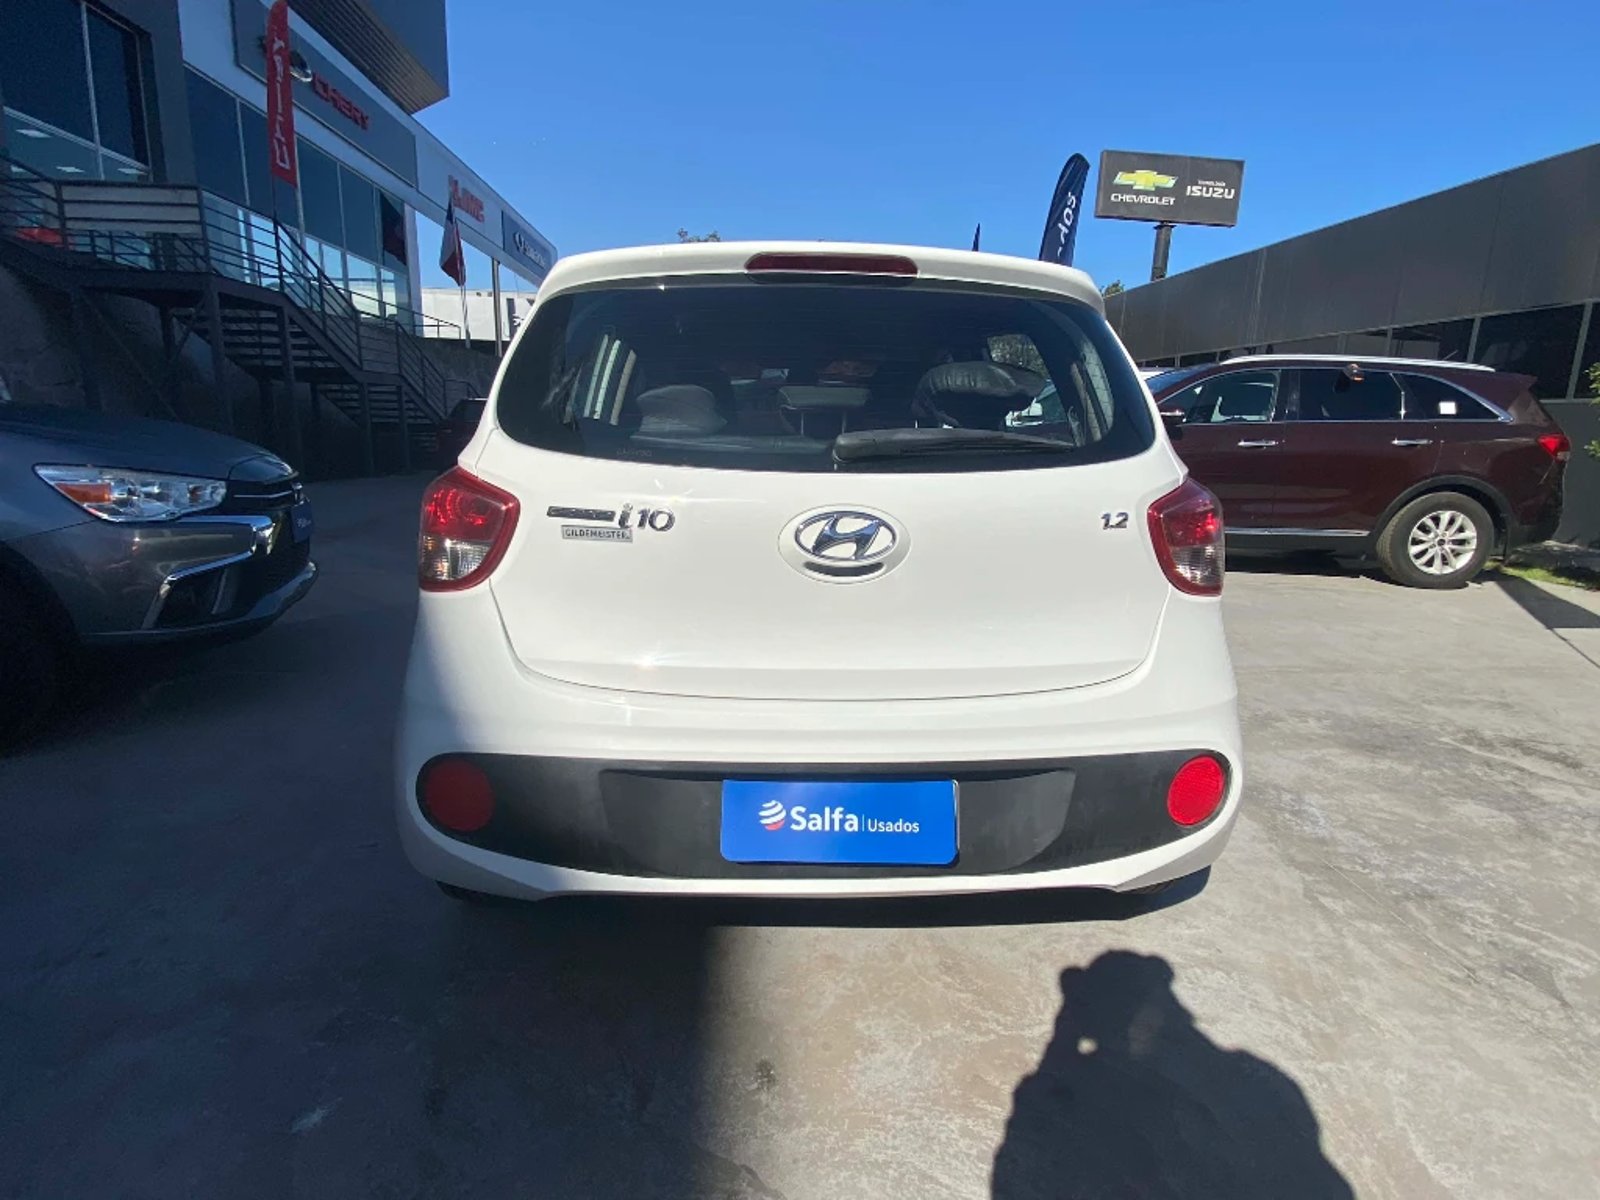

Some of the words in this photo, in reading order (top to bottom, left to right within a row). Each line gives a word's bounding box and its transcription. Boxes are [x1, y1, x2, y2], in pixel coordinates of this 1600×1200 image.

[1110, 193, 1176, 206] CHEVROLET
[1186, 185, 1235, 199] ISUZU
[618, 502, 675, 532] i10
[790, 806, 859, 833] Salfa
[867, 818, 920, 834] Usados
